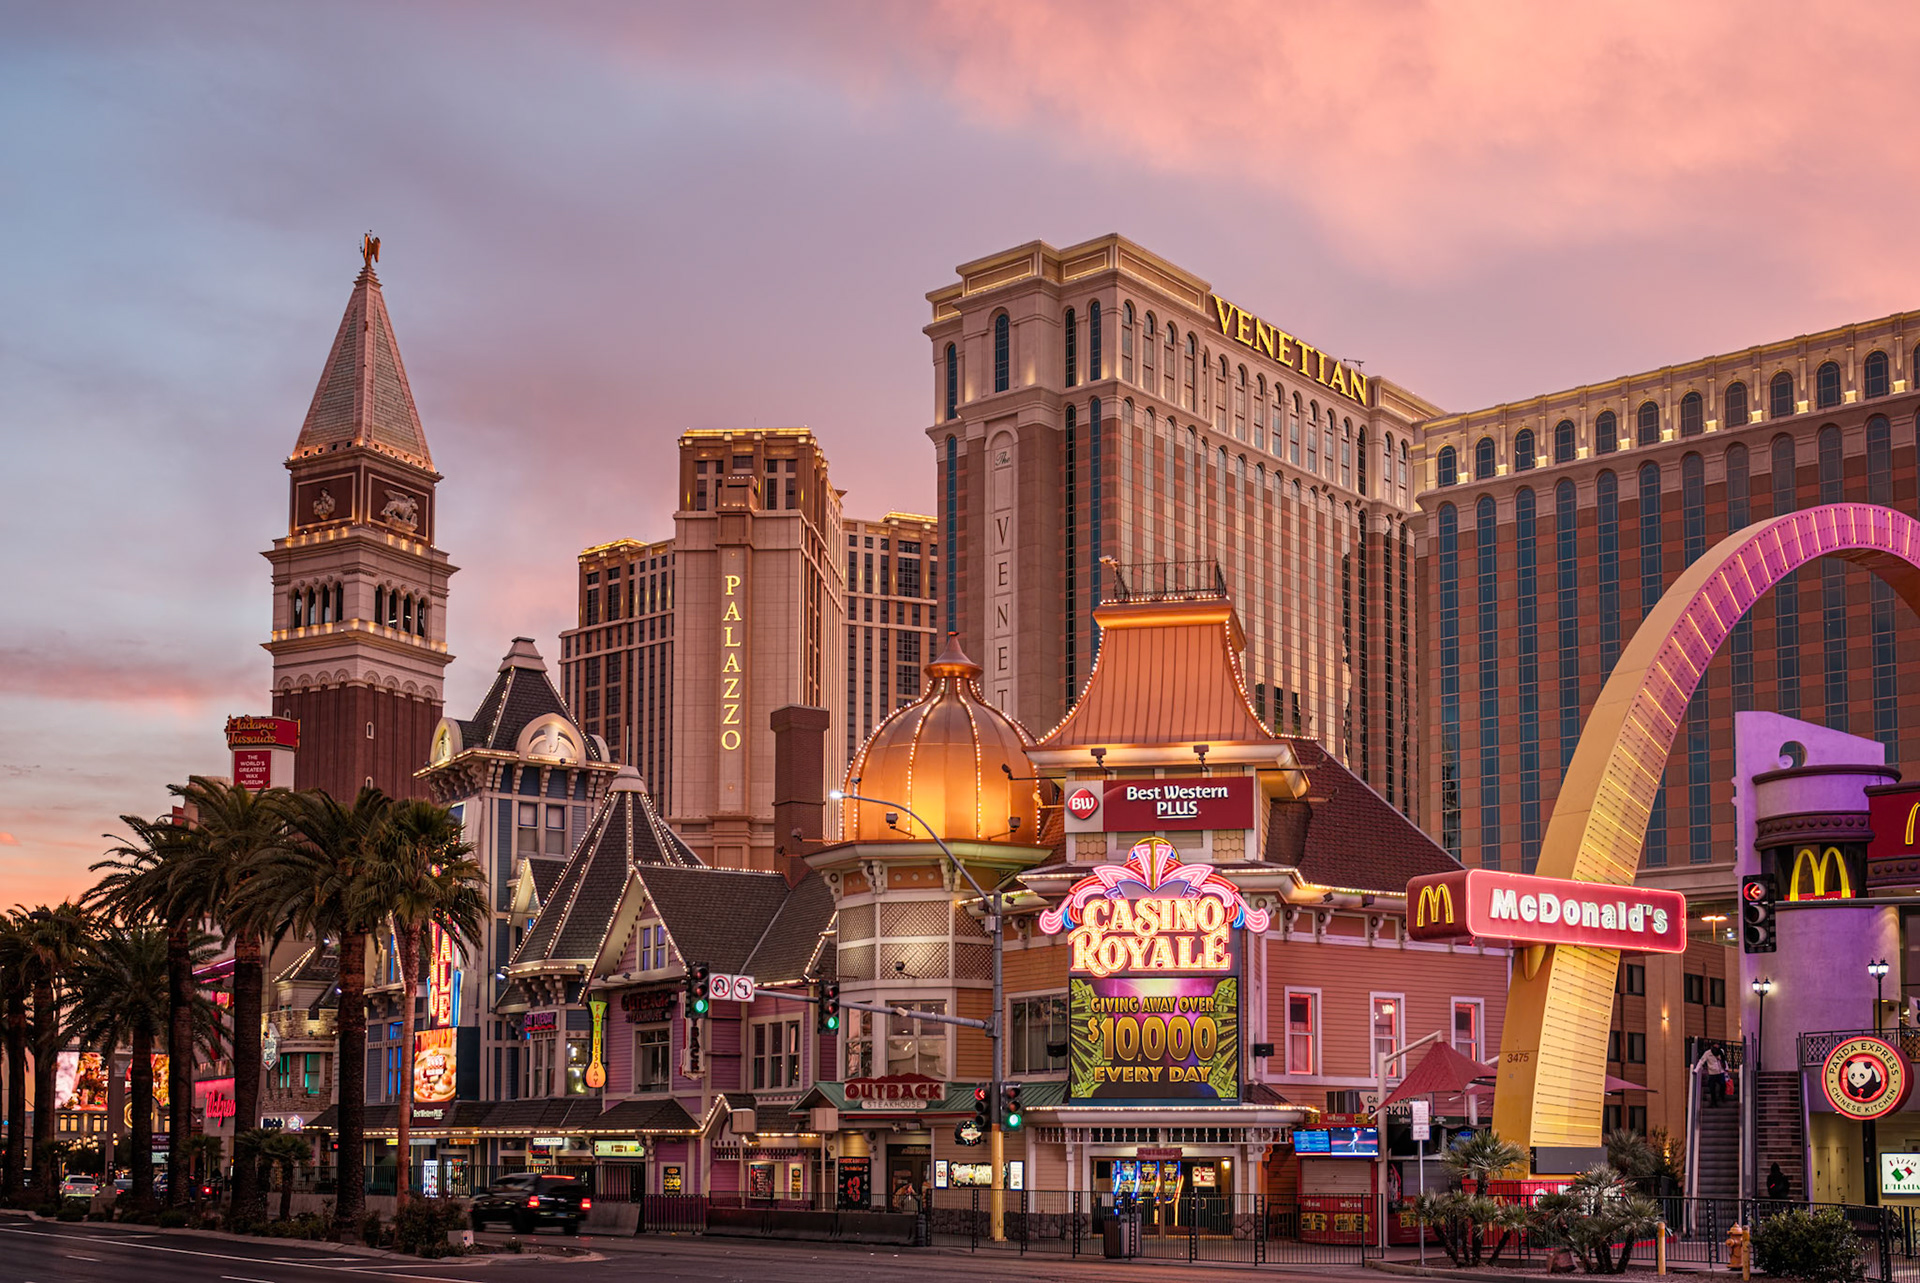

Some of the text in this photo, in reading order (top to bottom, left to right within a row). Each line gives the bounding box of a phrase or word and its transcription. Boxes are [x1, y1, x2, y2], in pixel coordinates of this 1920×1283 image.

[1213, 294, 1368, 406] VENETIAN
[995, 451, 1010, 466] The
[721, 575, 742, 750] PALAZZO
[227, 713, 278, 730] Madame
[225, 729, 277, 744] Tussauds
[1126, 785, 1228, 801] Best Western
[1071, 797, 1094, 810] BW
[1157, 801, 1197, 815] PLUS
[1082, 896, 1225, 937] CASINO
[1490, 888, 1668, 934] McDonald's
[1068, 922, 1232, 977] ROYALE
[1090, 997, 1214, 1013] GIVING AWAY OVER
[1087, 1016, 1217, 1062] $10,000
[1507, 1052, 1529, 1063] 3475
[1829, 1042, 1899, 1076] PANDA EXPRESS
[1094, 1066, 1212, 1083] EVERY DAY
[845, 1083, 942, 1099] OUTBACK
[867, 1100, 921, 1108] STEAKHOUSE
[1831, 1087, 1896, 1112] CHINESE KITCHEN
[1368, 1105, 1411, 1115] PRKIN
